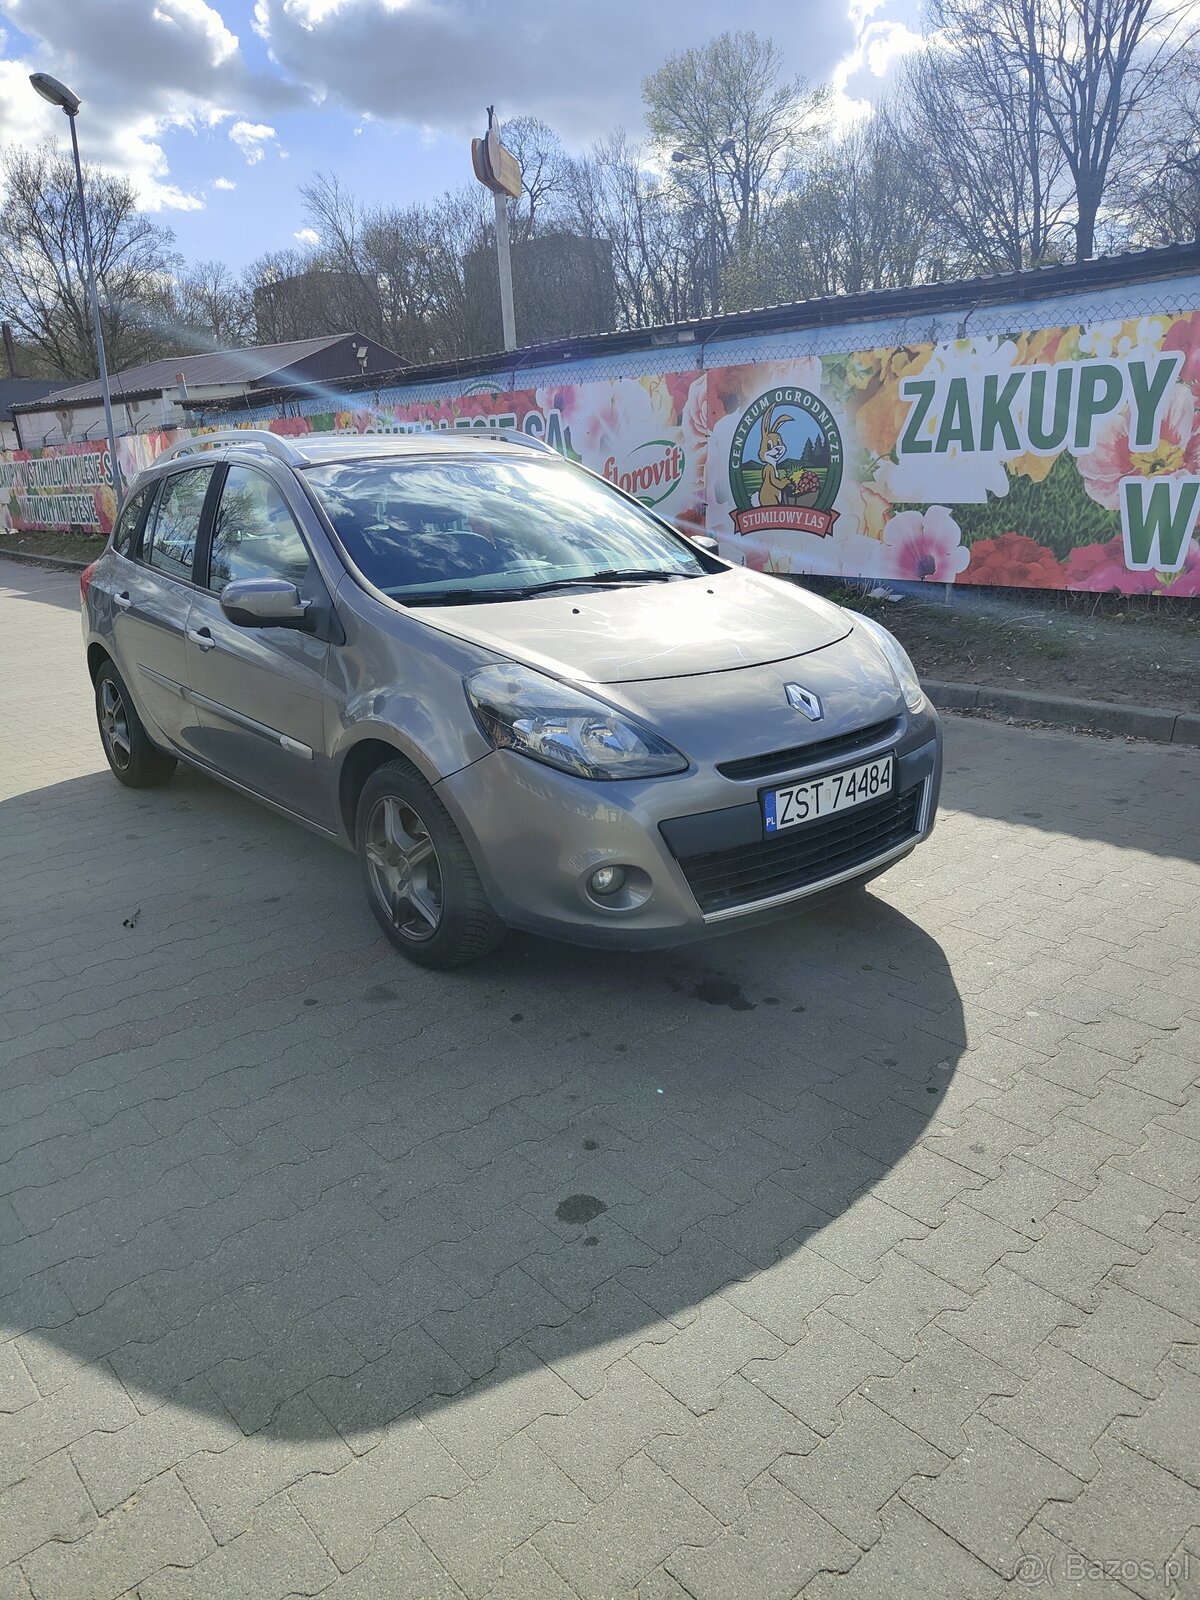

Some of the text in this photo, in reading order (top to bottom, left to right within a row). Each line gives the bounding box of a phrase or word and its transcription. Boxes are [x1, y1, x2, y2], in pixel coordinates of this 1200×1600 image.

[731, 390, 840, 469] CENTRUM OGRODNICZE
[900, 357, 1179, 455] ZAKUPY
[602, 446, 681, 493] florovit
[742, 509, 825, 529] STUMILOWY LAS
[1124, 482, 1200, 566] W
[766, 816, 776, 827] PL
[779, 759, 891, 825] ZST 74484
